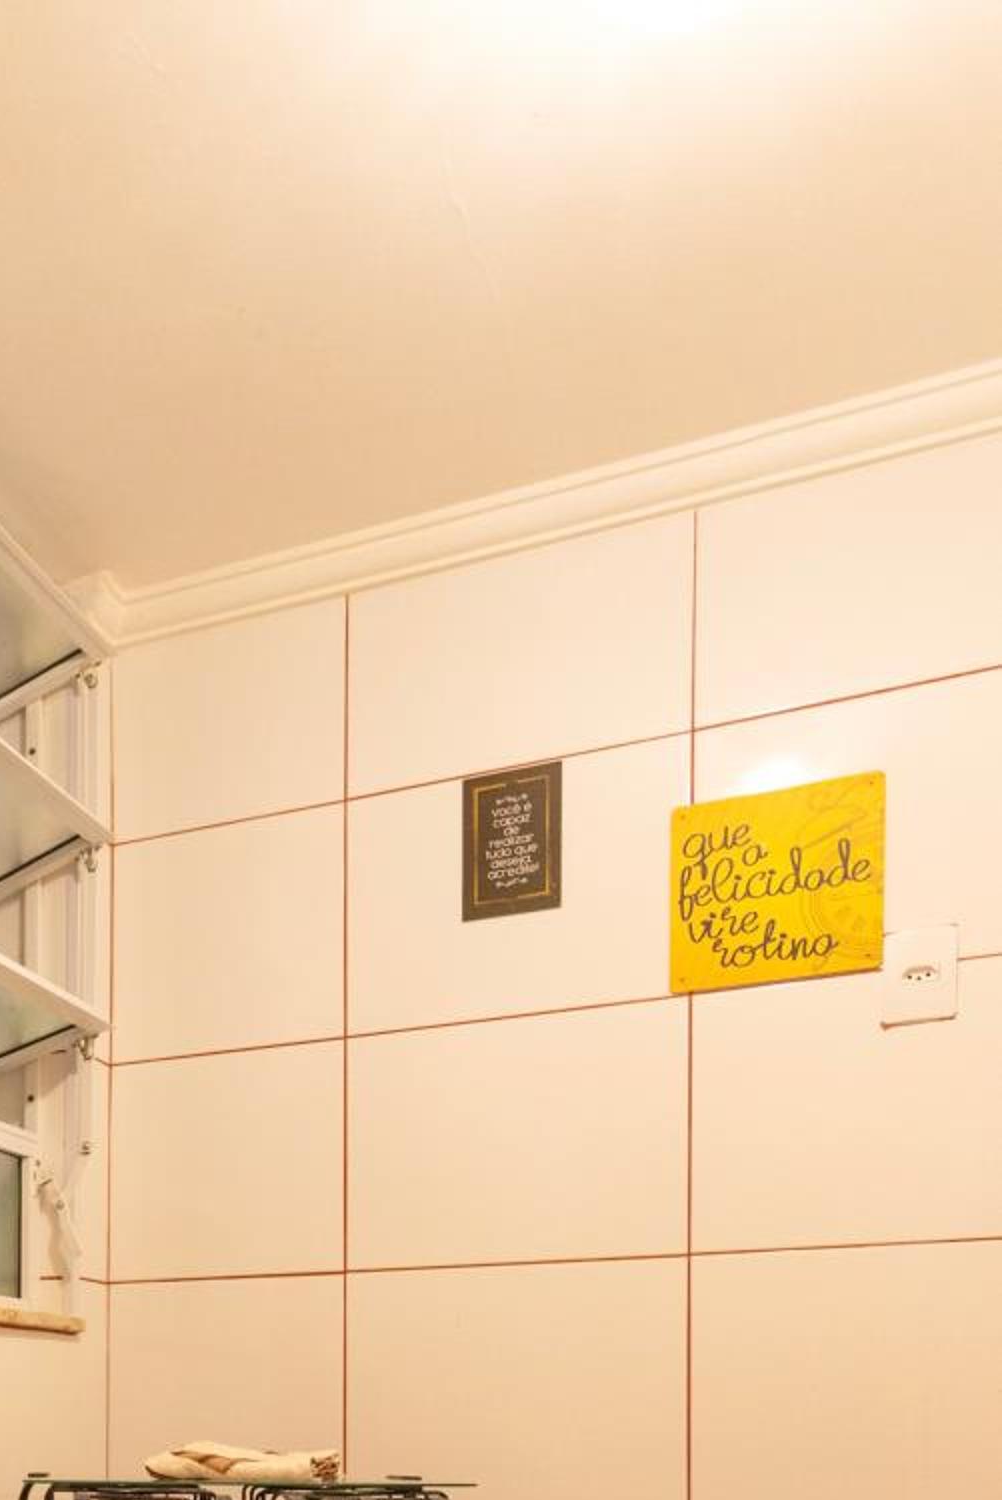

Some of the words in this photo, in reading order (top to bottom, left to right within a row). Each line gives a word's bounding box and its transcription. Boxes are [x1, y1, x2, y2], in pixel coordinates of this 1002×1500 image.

[682, 823, 753, 880] que
[742, 843, 769, 866] a
[679, 837, 871, 922] felicidade
[689, 907, 760, 943] vire
[712, 919, 840, 968] rotina
